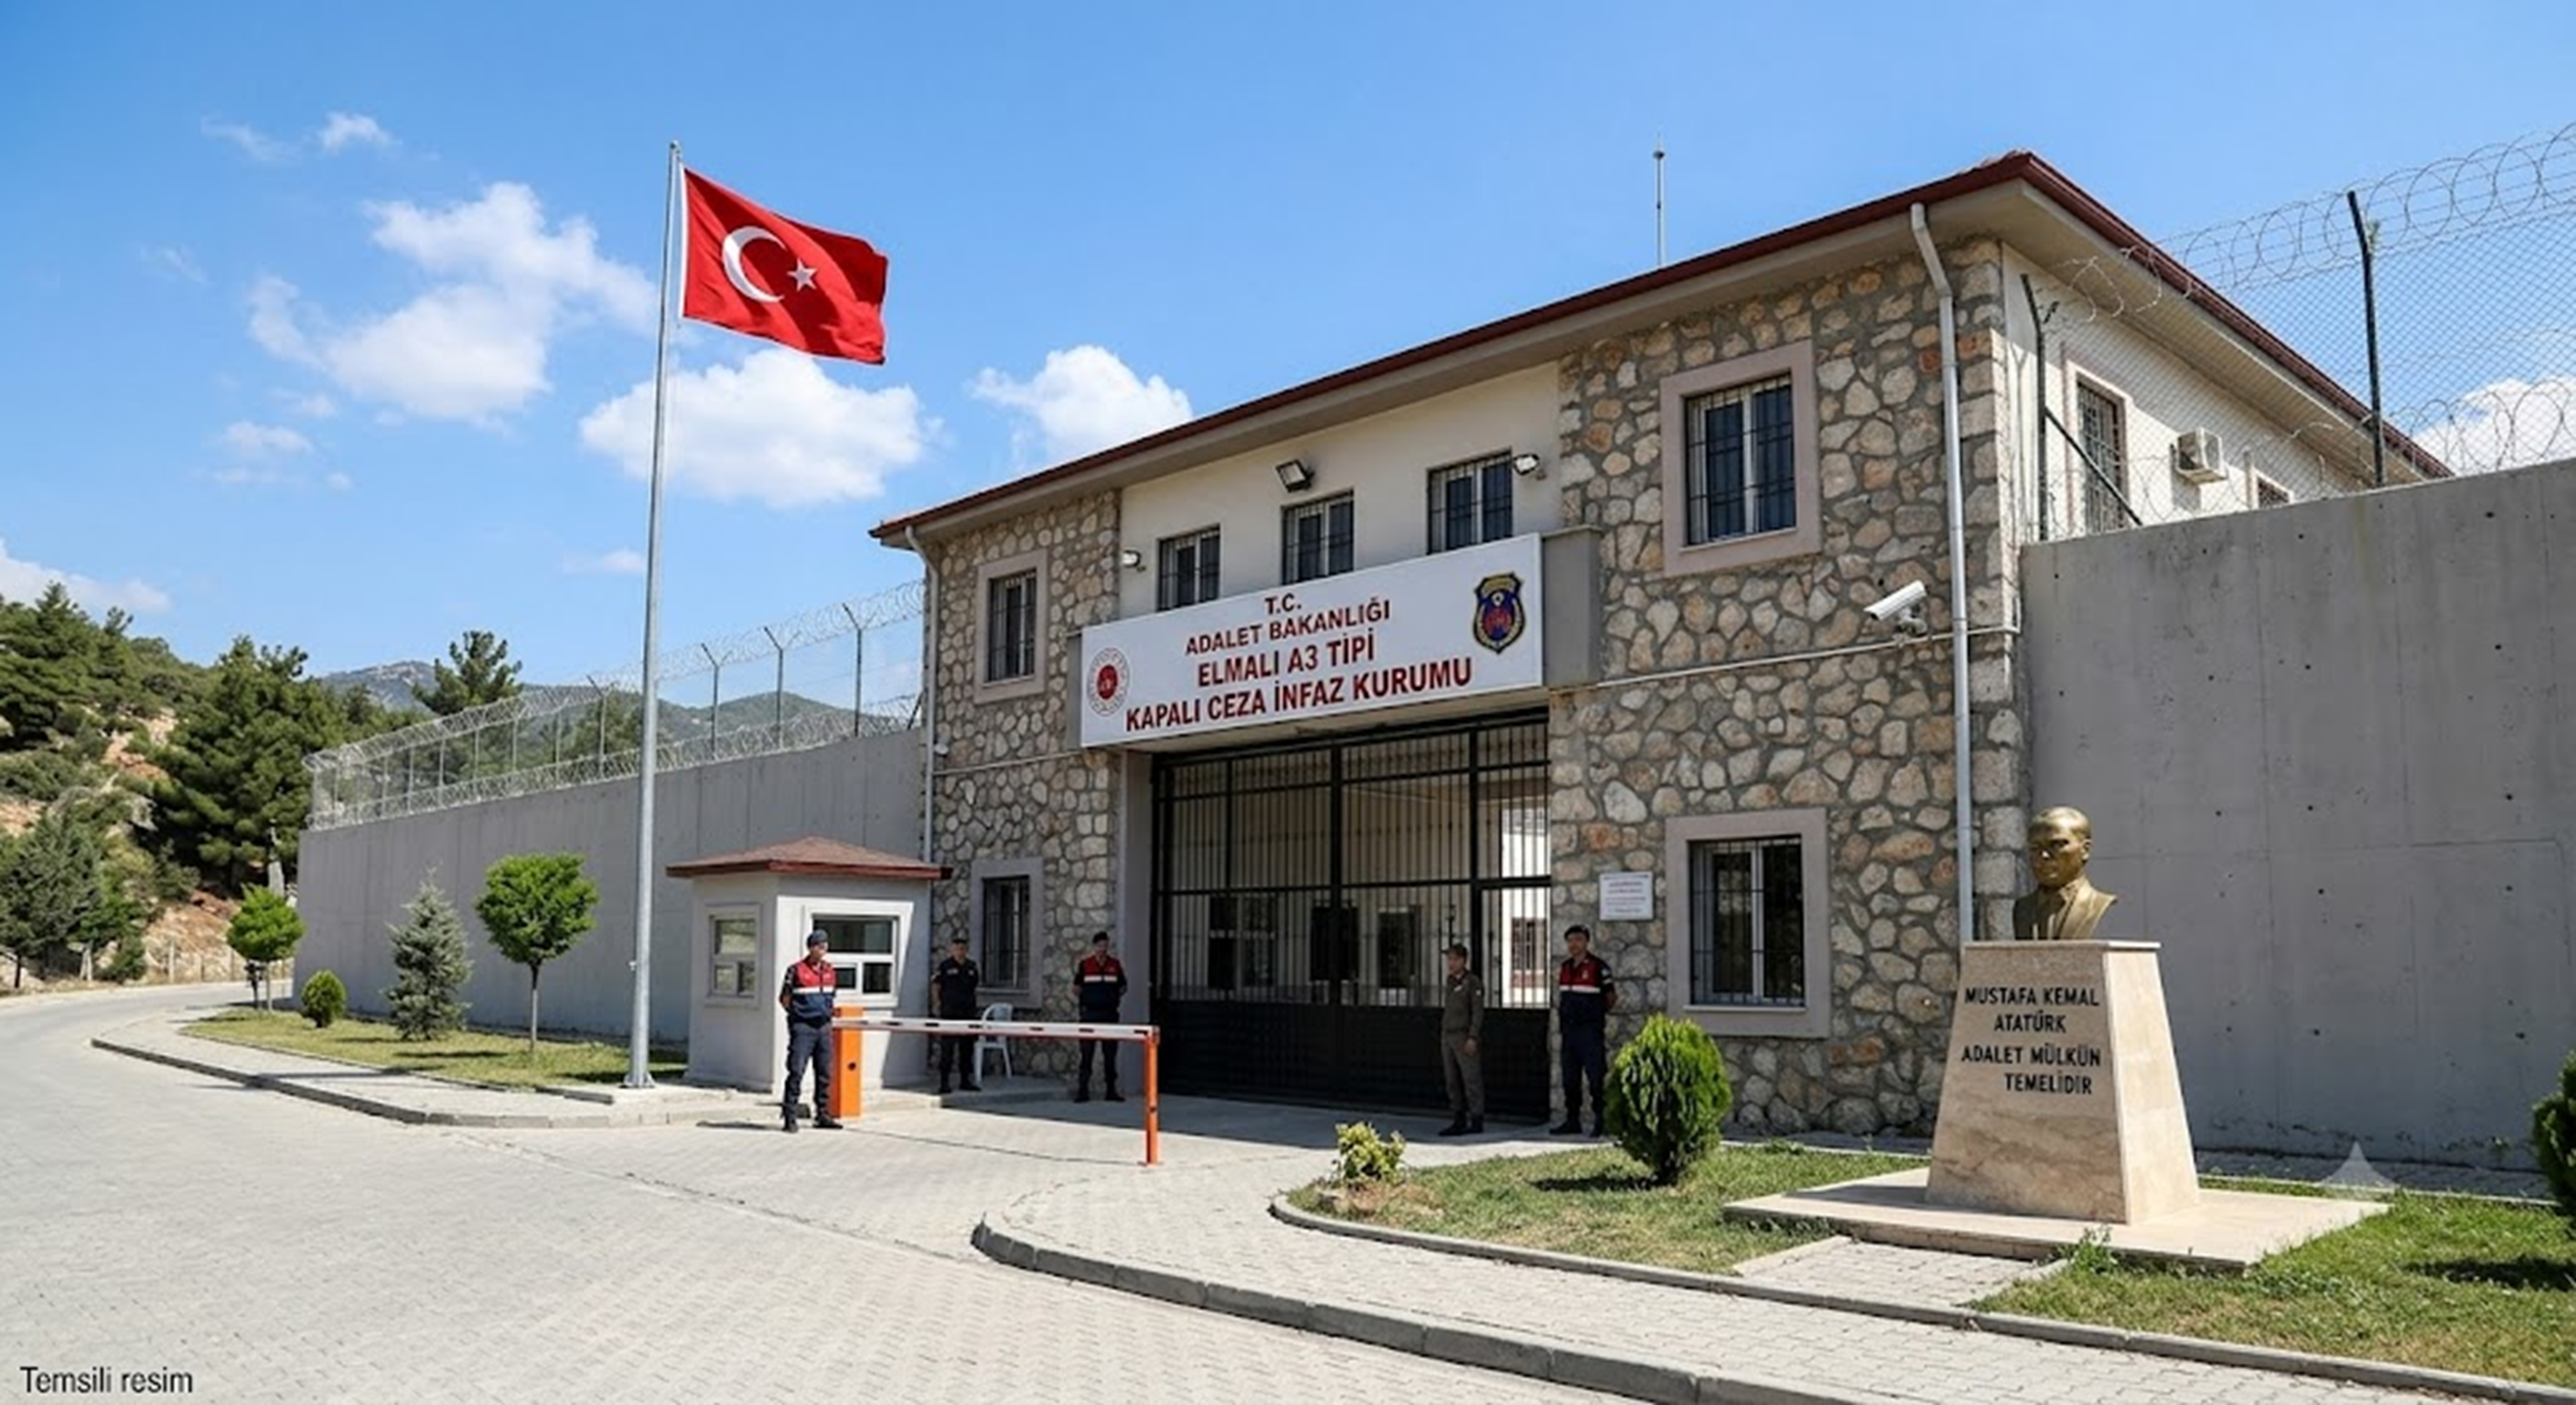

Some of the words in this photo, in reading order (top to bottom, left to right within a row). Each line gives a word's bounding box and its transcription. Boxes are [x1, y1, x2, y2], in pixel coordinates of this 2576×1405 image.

[1265, 593, 1302, 615] T.C.
[1186, 624, 1262, 655] ADALET
[1269, 597, 1390, 641] BAKANLIĞI
[1198, 650, 1280, 687] ELMALI
[1287, 644, 1318, 673] A3
[1326, 627, 1373, 667] TİPİ
[1126, 698, 1200, 732] KAPALI
[1208, 688, 1266, 721] CEZA
[1274, 681, 1345, 712] İNFAZ
[1353, 657, 1472, 701] KURUMU
[1964, 987, 2036, 1004] MUSTAFA
[2044, 987, 2100, 1006] KEMAL
[1993, 1009, 2066, 1033] ATATÜRK
[1961, 1045, 2023, 1065] ADALET
[2030, 1042, 2101, 1067] MÜLKÜN
